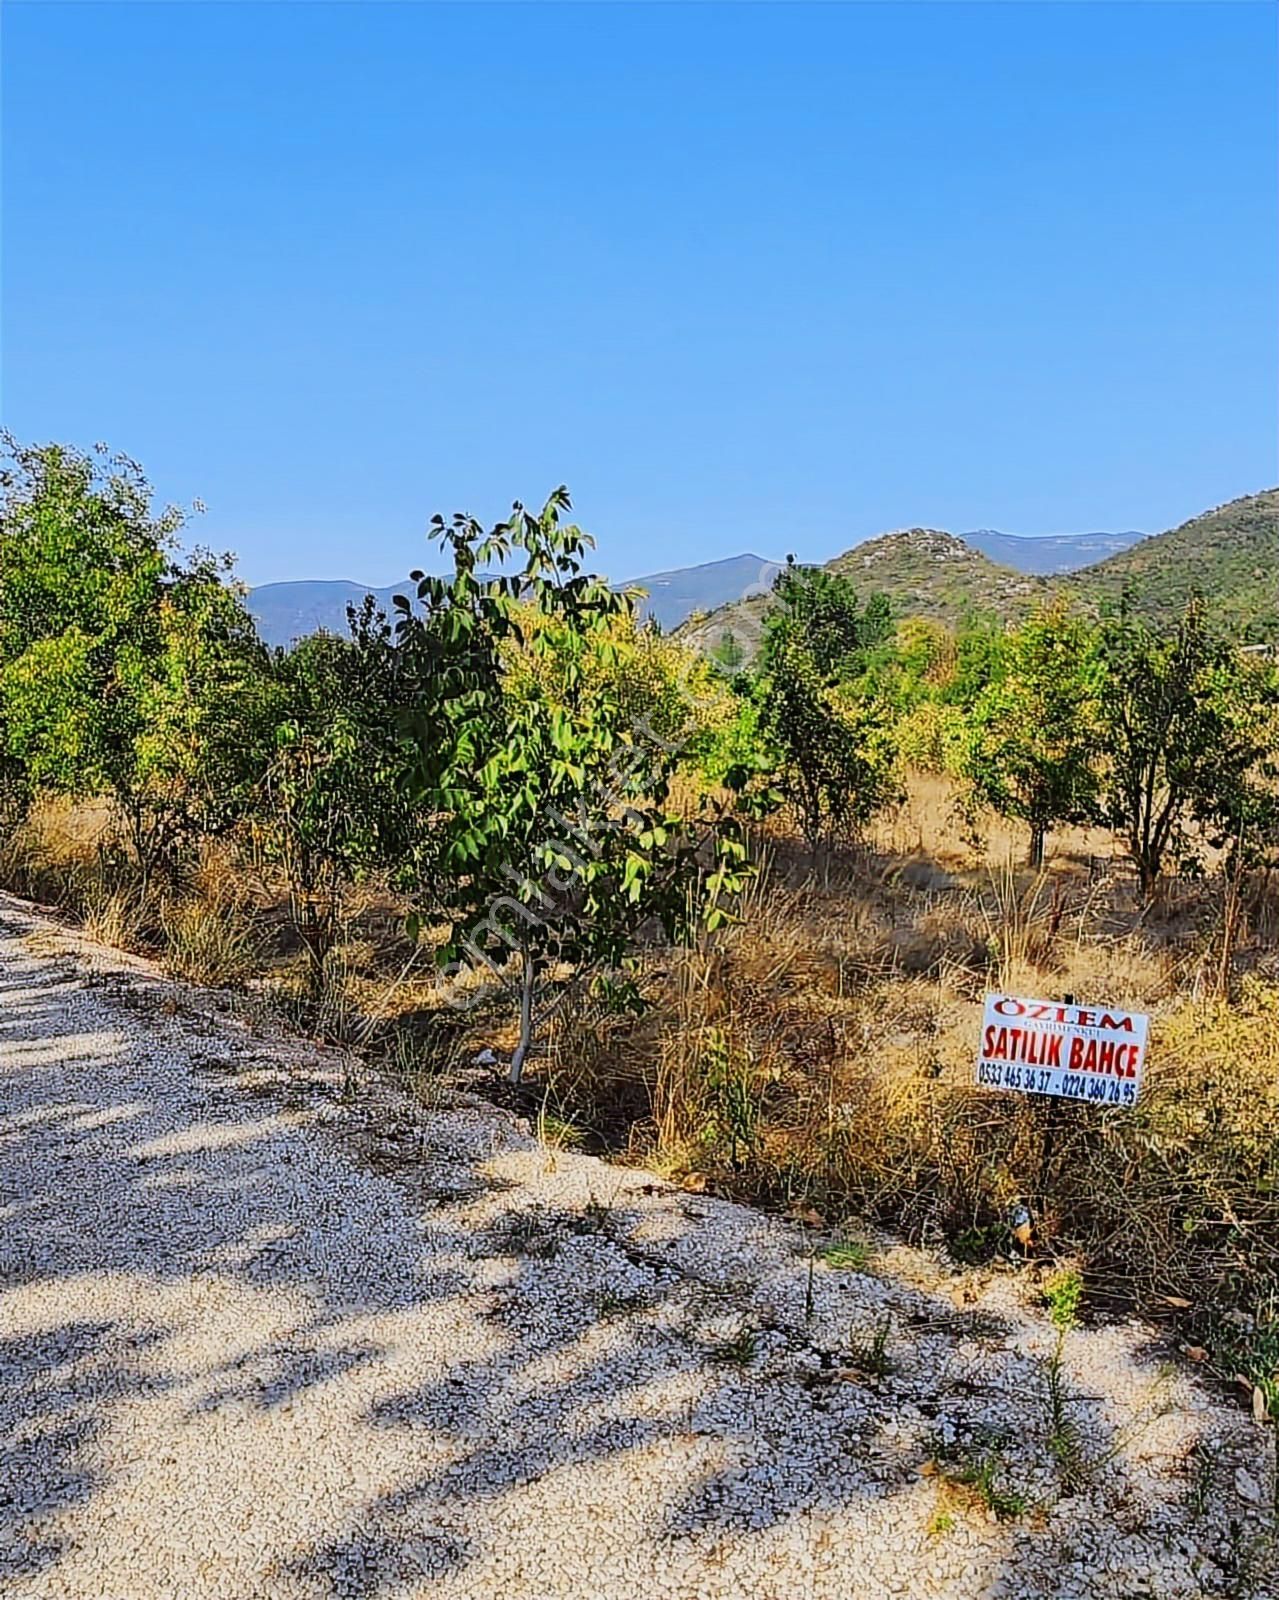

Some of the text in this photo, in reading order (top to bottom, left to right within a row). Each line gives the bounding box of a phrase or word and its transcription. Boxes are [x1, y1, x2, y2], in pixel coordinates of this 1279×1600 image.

[994, 998, 1136, 1033] ÖZLEM
[983, 1025, 1139, 1081] SATILIK BAHÇE
[979, 1062, 1003, 1086] 0533
[1004, 1066, 1022, 1088] 465
[1024, 1069, 1036, 1090] 36
[1038, 1070, 1052, 1092] 37
[1062, 1074, 1086, 1097] 0224
[1087, 1077, 1107, 1101] 360
[1108, 1080, 1121, 1103] 26
[1122, 1083, 1136, 1105] 95
